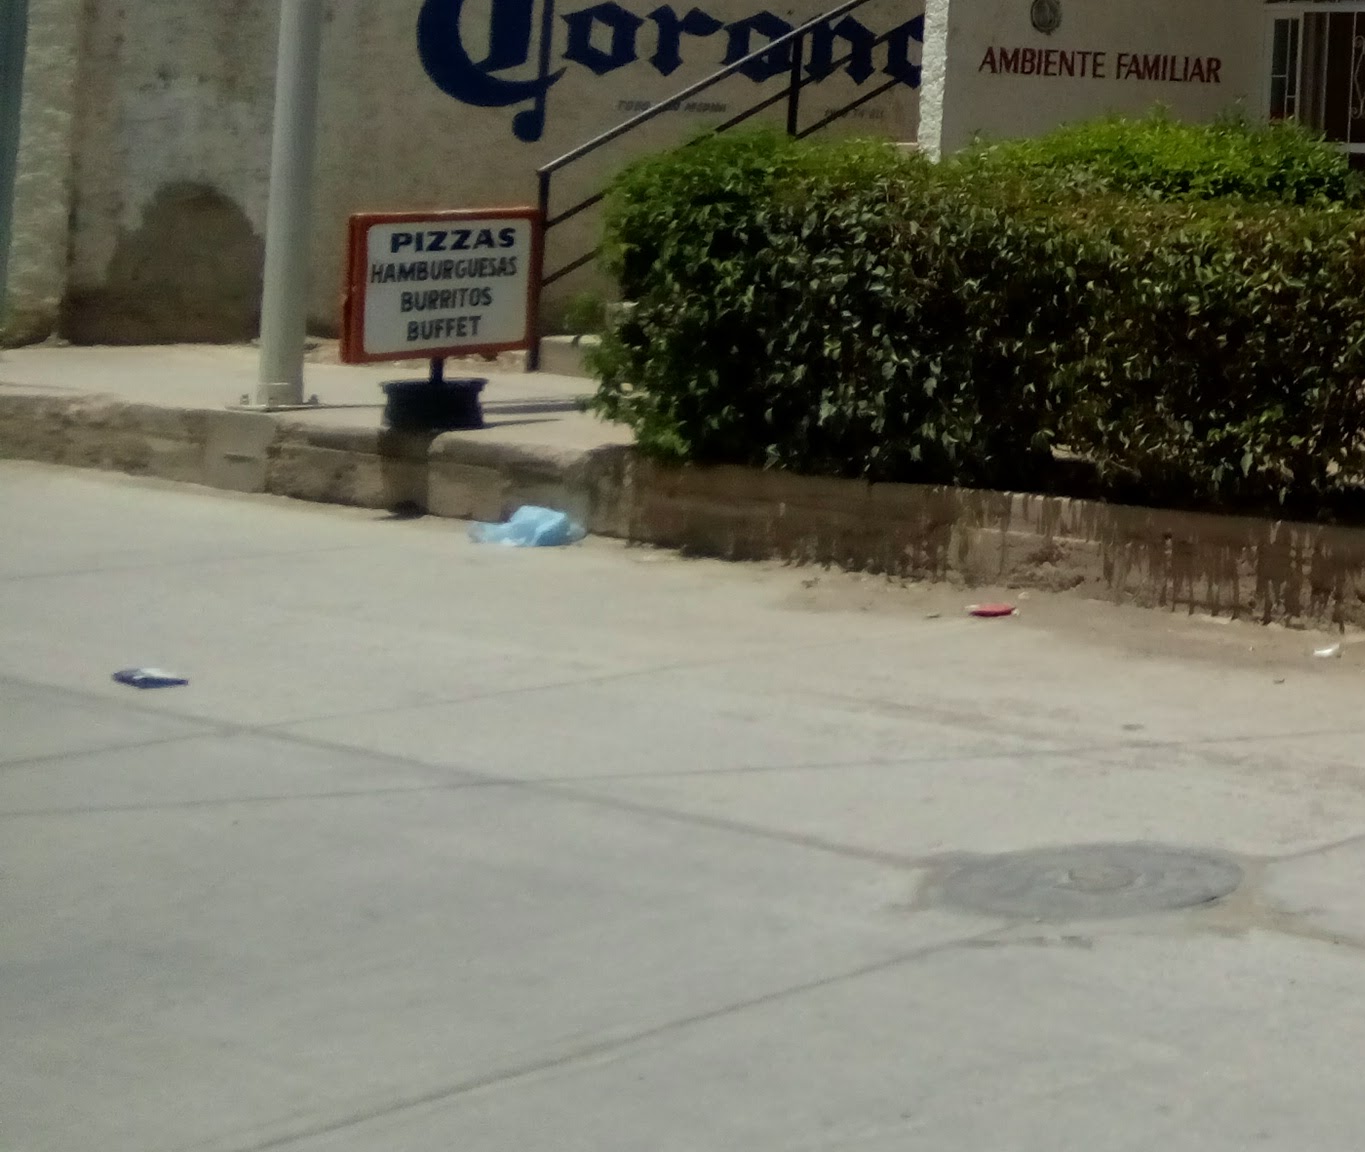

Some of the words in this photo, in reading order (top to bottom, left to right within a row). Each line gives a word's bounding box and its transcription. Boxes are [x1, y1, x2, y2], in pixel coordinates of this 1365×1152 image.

[978, 46, 1106, 79] AMBIENTE
[1115, 52, 1222, 84] FAMILIAR
[390, 227, 517, 254] PIZZAS
[370, 256, 518, 284] HAMBURGUESAS
[400, 286, 493, 313] BURRITOS
[406, 315, 482, 342] BUFFET
